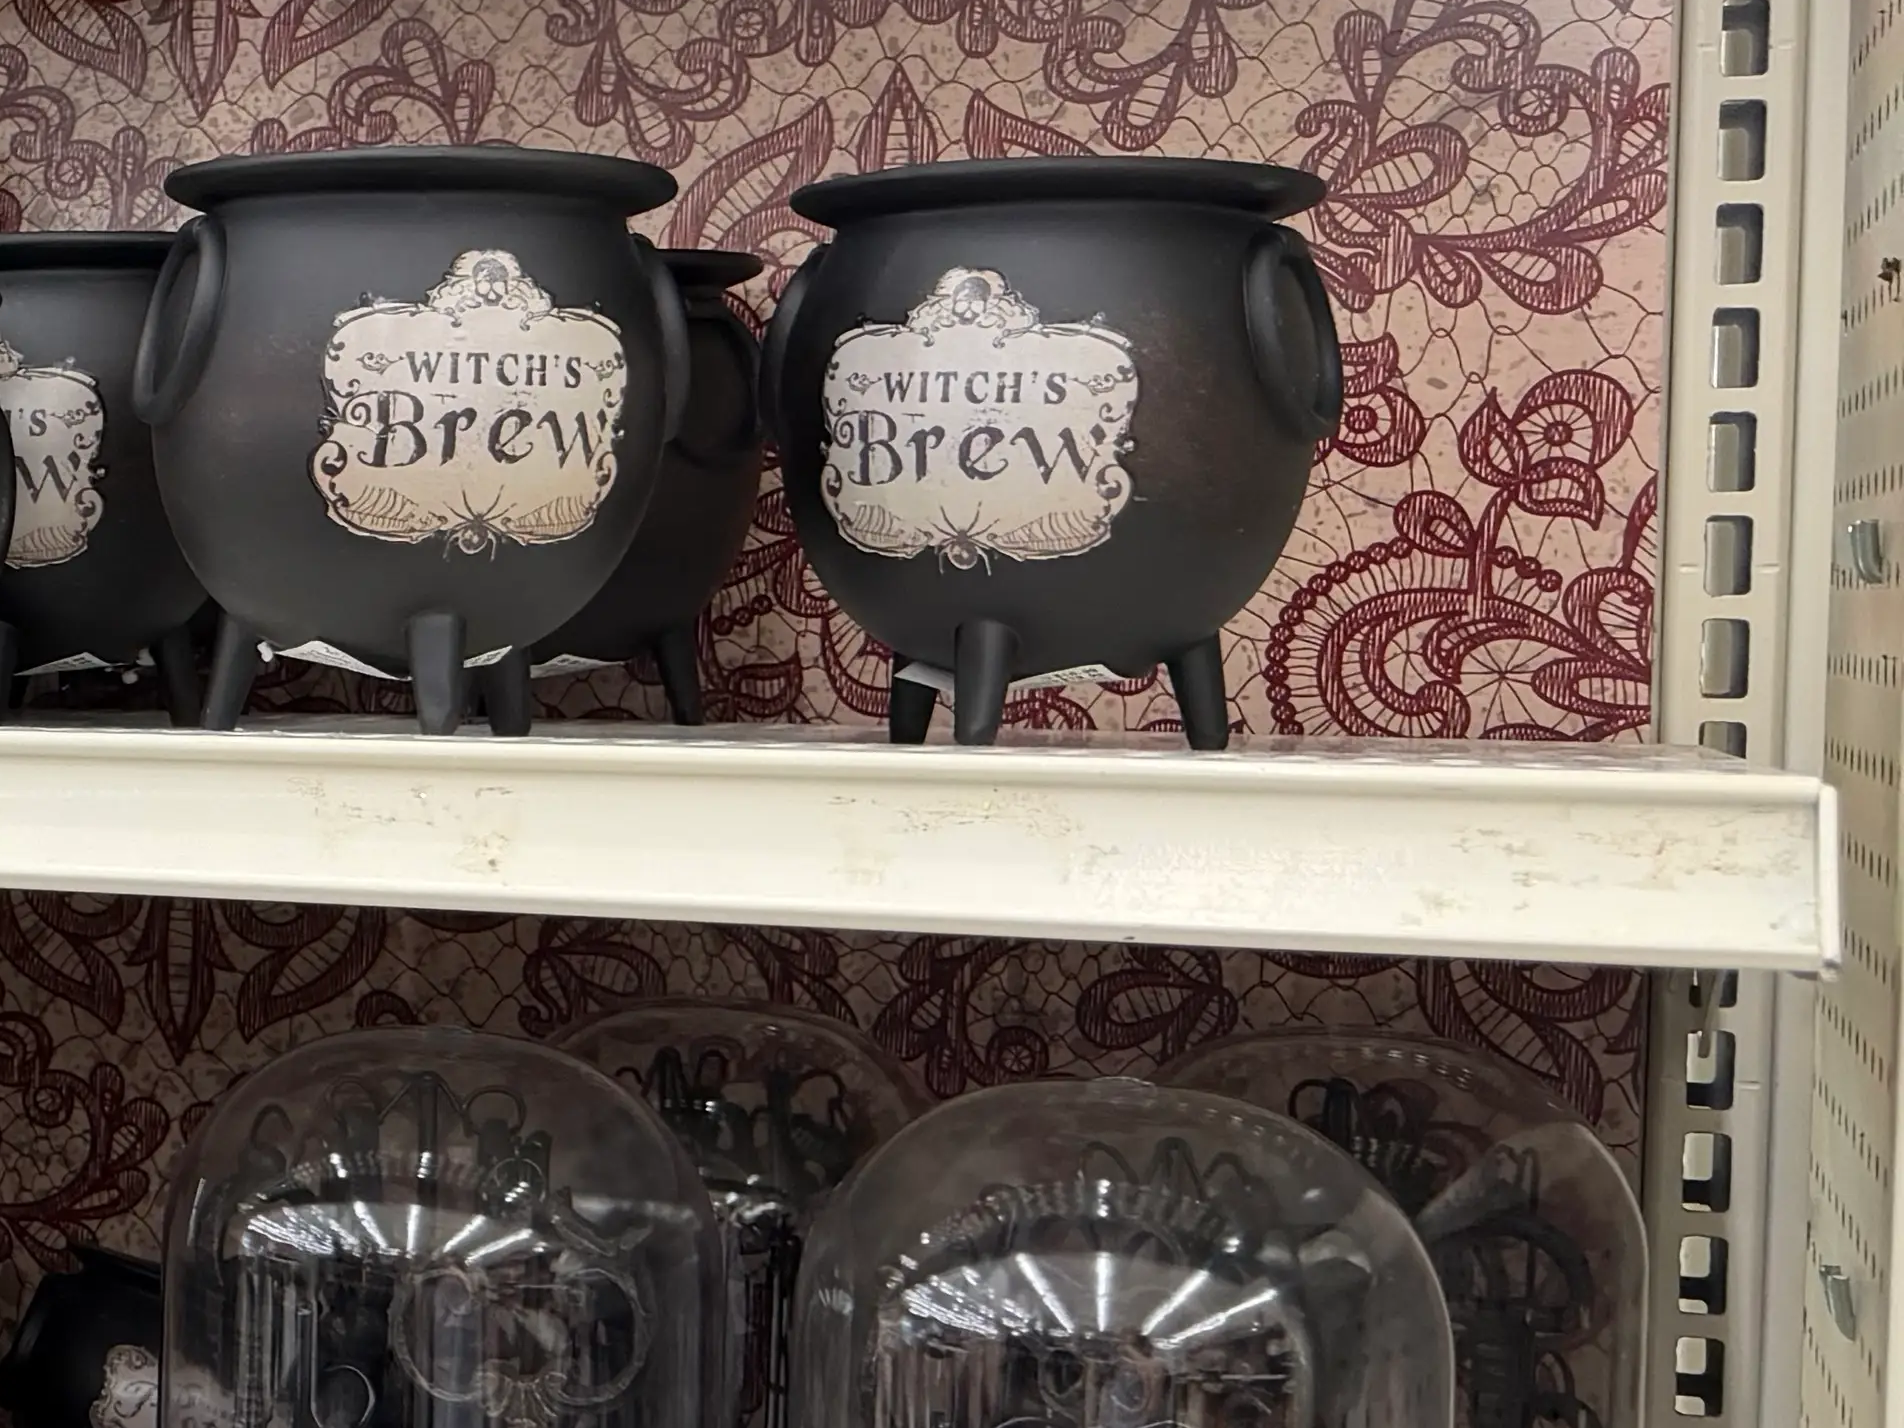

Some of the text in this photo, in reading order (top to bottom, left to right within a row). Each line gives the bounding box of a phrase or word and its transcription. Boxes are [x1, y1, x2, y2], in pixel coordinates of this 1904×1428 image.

[405, 350, 582, 389] WITCH'S
[883, 370, 1068, 405] WITCH'S
[342, 389, 611, 470] Brew
[833, 409, 1108, 487] Brew
